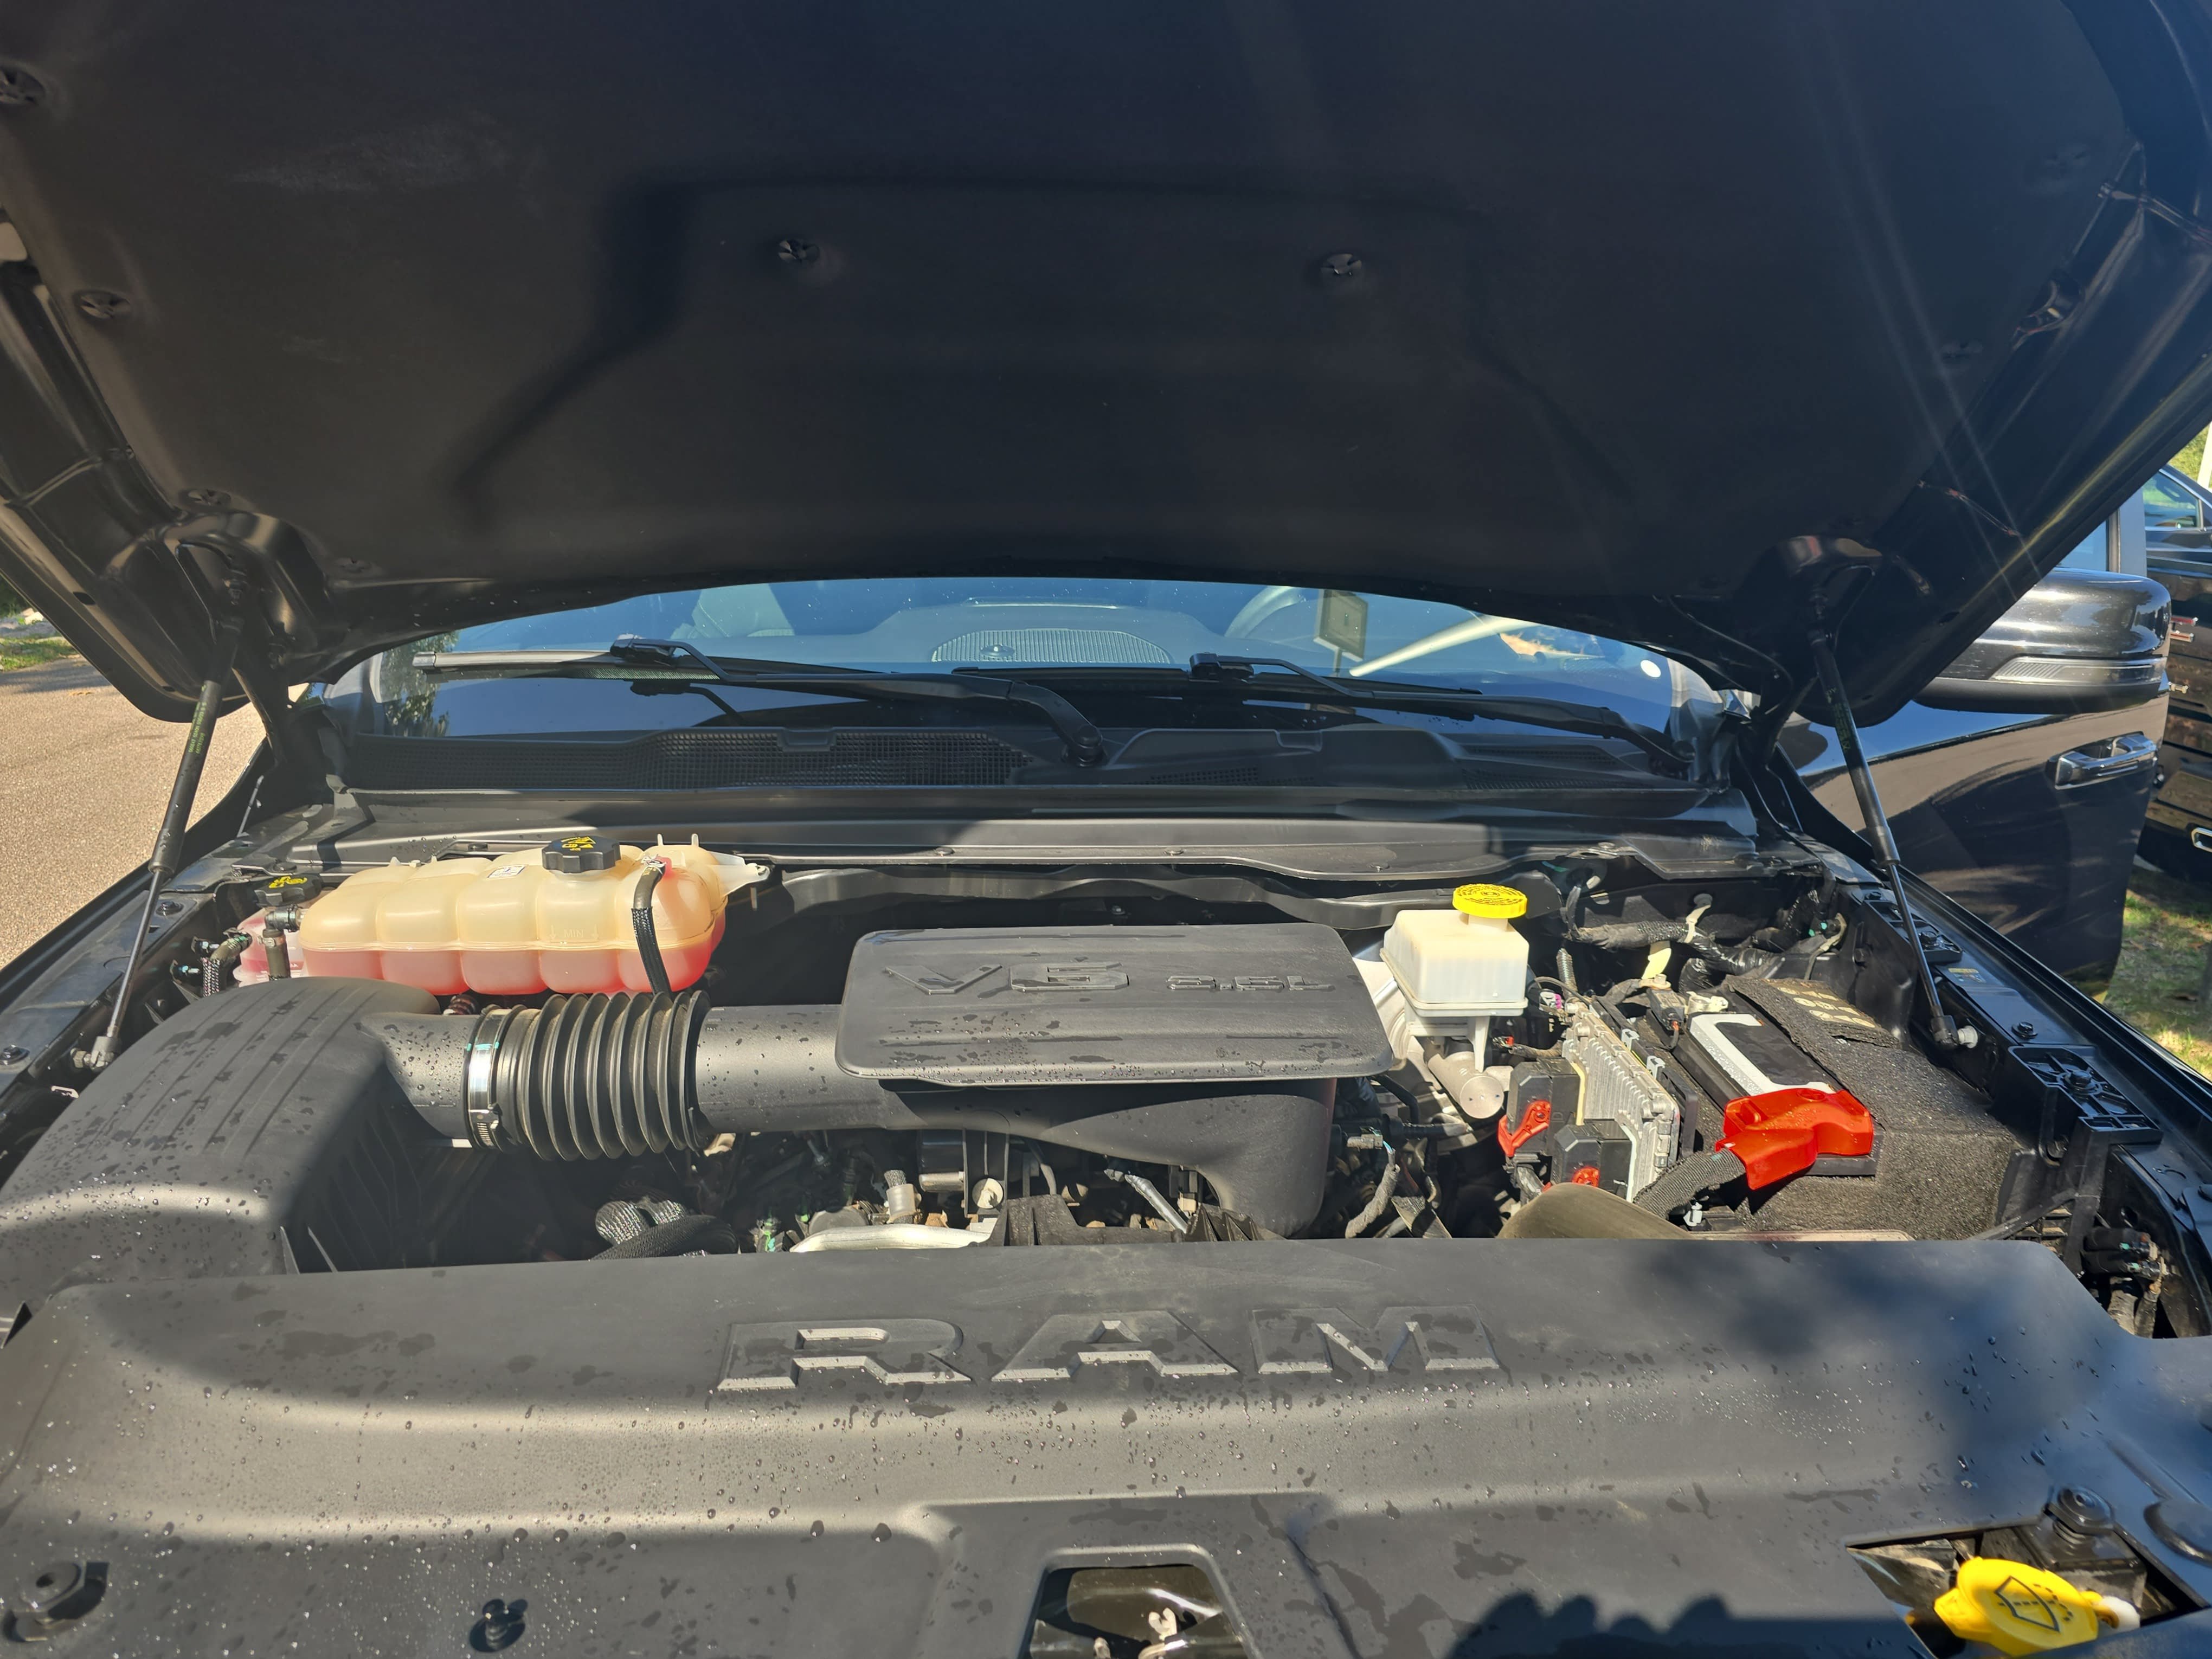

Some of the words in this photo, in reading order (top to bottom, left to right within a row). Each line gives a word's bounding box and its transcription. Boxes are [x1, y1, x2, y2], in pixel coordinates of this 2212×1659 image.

[563, 928, 584, 938] MIN
[884, 962, 1130, 994] V6
[717, 1304, 1500, 1392] RAM
